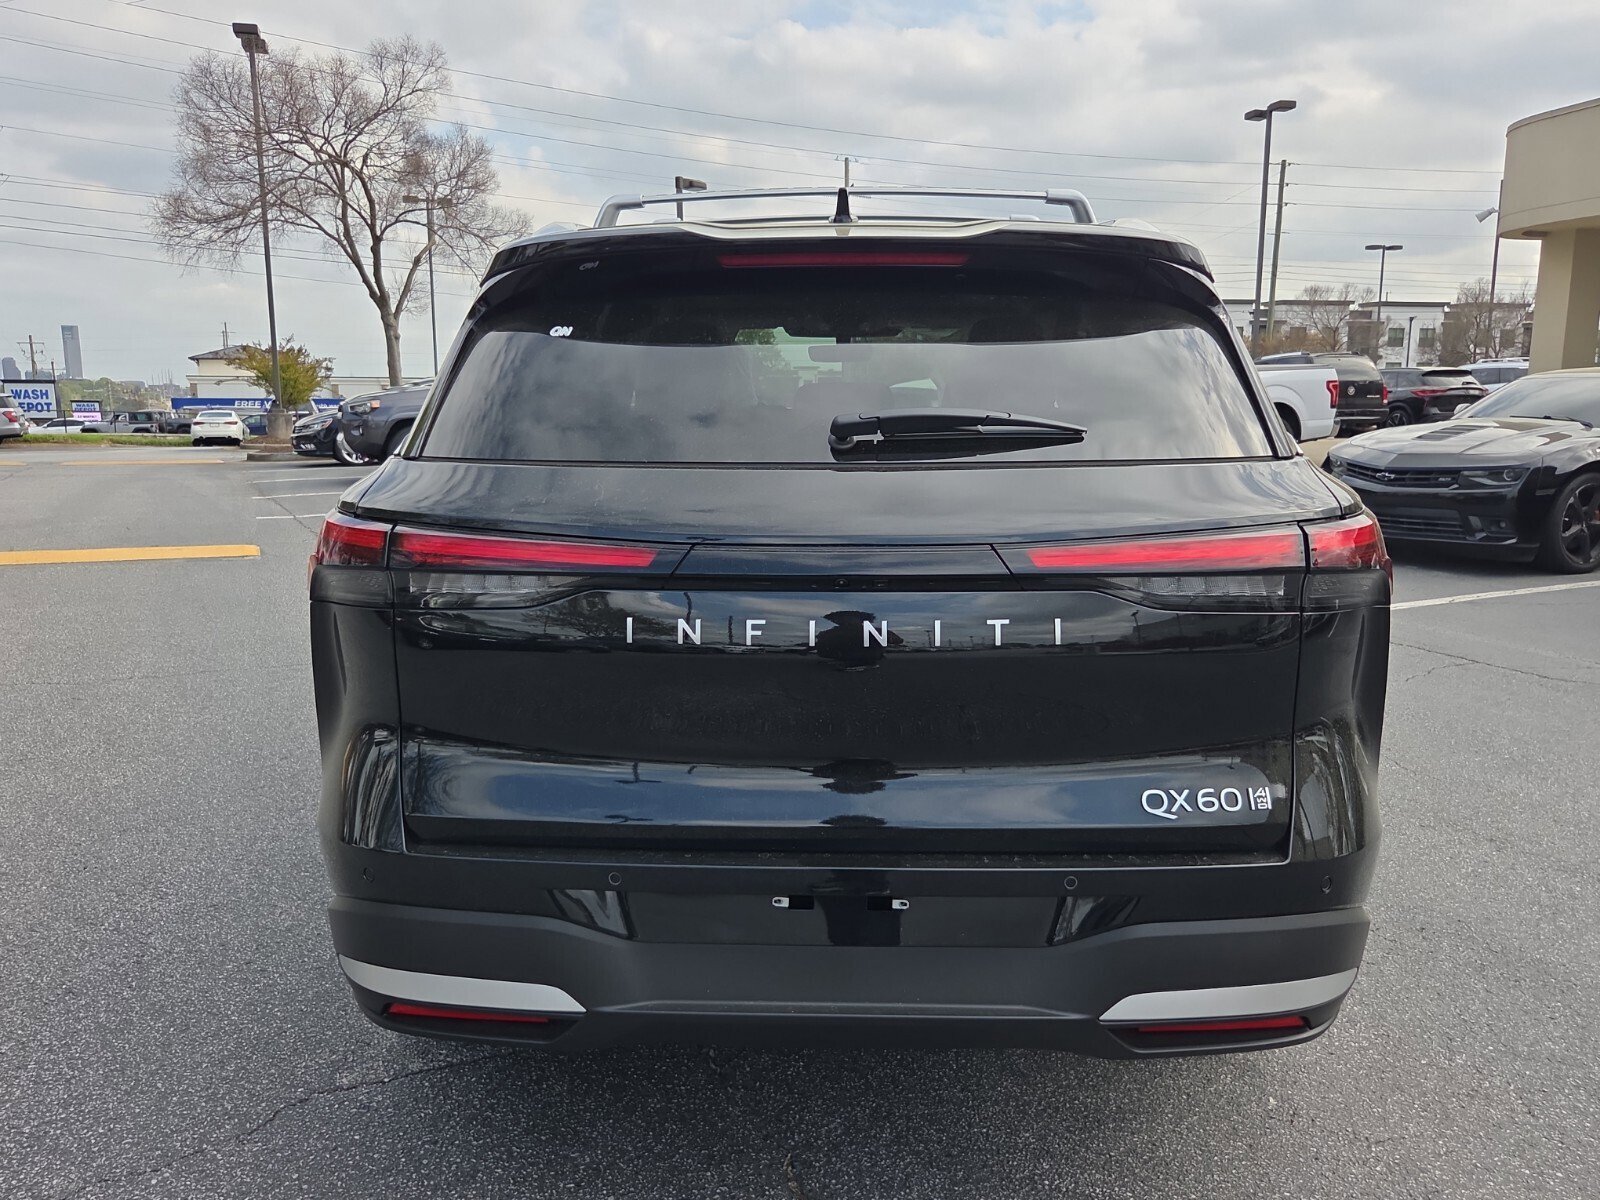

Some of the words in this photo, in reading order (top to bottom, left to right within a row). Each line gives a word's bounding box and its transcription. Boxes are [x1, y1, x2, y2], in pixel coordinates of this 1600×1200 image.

[11, 389, 49, 400] WASH
[18, 402, 53, 413] EPOT
[234, 400, 262, 408] FREE
[626, 617, 1062, 648] INFINITI
[1141, 787, 1243, 820] QX60
